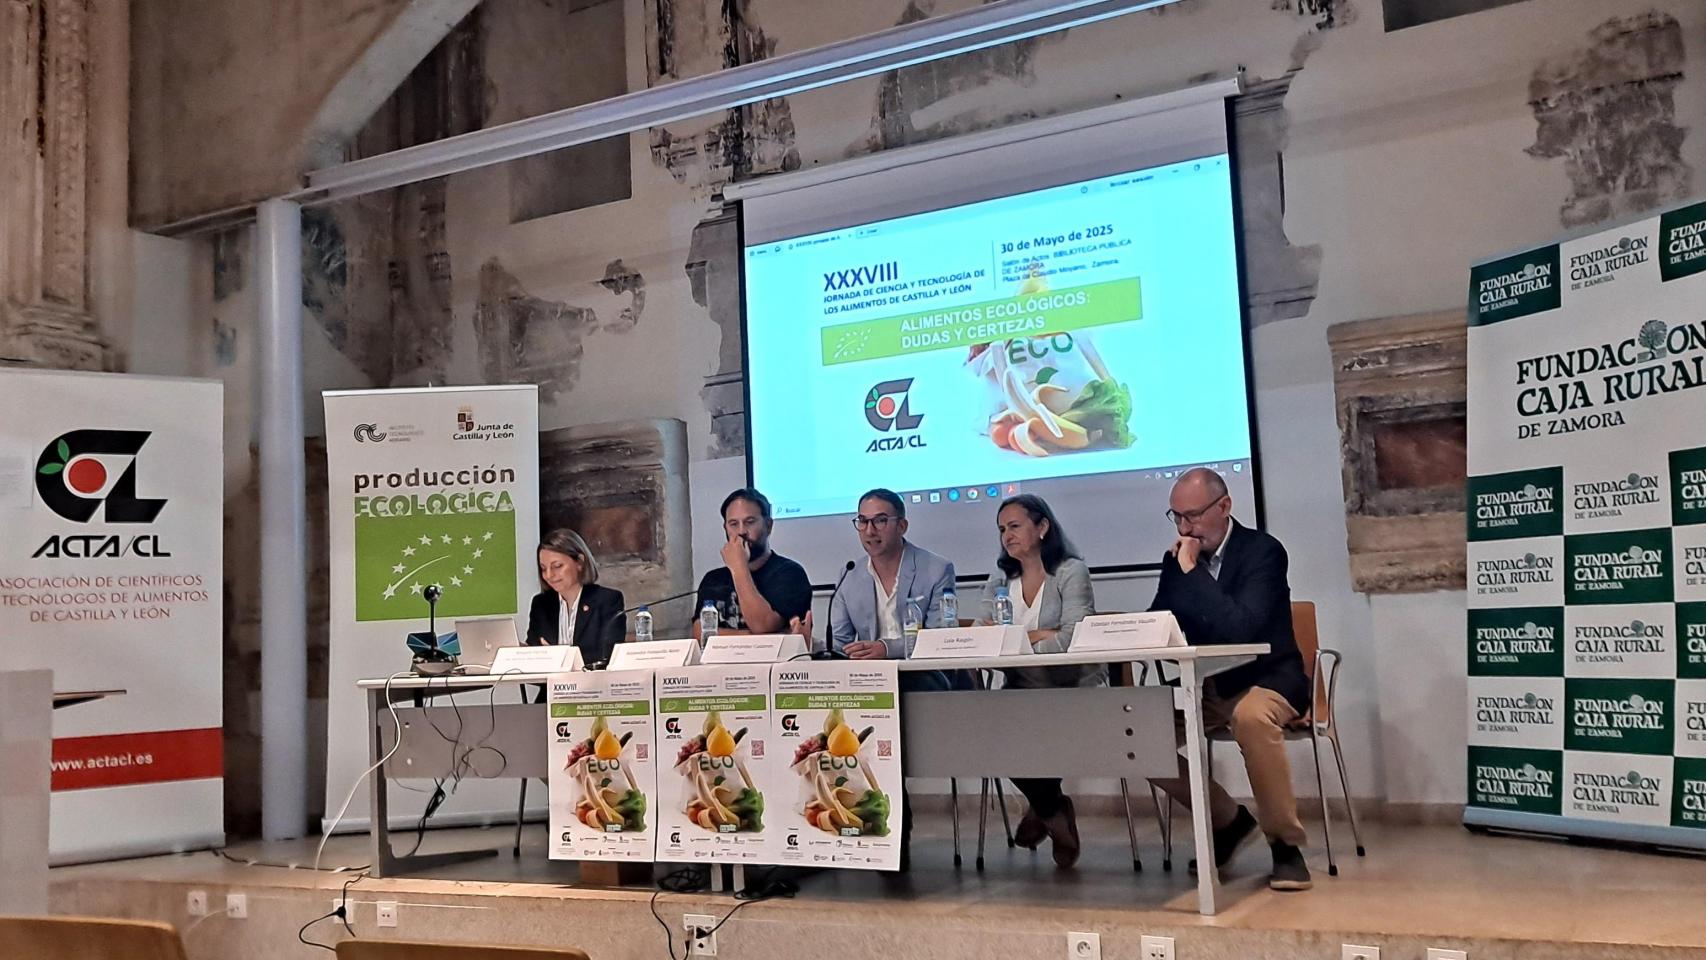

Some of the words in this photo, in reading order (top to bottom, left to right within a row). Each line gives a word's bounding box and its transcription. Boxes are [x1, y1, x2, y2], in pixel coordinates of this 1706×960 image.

[1001, 243, 1014, 254] 30
[1017, 240, 1030, 250] de
[1034, 235, 1064, 248] Mayo
[1068, 231, 1082, 241] de
[1086, 224, 1113, 238] 2025
[1669, 234, 1704, 254] CAJA
[1054, 246, 1097, 258] BIBLIOTECA
[1670, 256, 1682, 264] DE
[1014, 262, 1044, 272] ZAMORA
[1570, 266, 1601, 281] CAJA
[1605, 250, 1648, 272] RURAL
[824, 261, 898, 292] XXXVIII
[824, 291, 861, 303] JORNADA
[864, 288, 874, 297] DE
[876, 284, 908, 294] CIENCIA
[918, 271, 972, 288] TECNOLOGÍA
[974, 270, 986, 278] DE
[1480, 289, 1508, 304] CAJA
[1510, 278, 1552, 297] RURAL
[824, 306, 838, 314] LOS
[840, 298, 887, 312] ALIMENTOS
[889, 296, 900, 304] DE
[902, 290, 939, 302] CASTILLA
[950, 284, 972, 294] LEÓN
[901, 308, 982, 331] ALIMENTOS
[986, 291, 1090, 318] ECOLÓGICOS:
[902, 330, 950, 349] DUDAS
[954, 329, 963, 341] Y
[967, 316, 1045, 339] CERTEZAS
[1008, 331, 1074, 365] ECO
[1517, 380, 1593, 416] CAJA
[1603, 356, 1706, 404] RURAL
[453, 432, 483, 440] Castilla
[1518, 423, 1541, 439] DE
[866, 434, 927, 453] ACTA/CL
[354, 464, 514, 493] producción
[1574, 496, 1609, 510] CAJA
[1612, 490, 1660, 508] RURAL
[1477, 505, 1507, 520] CAJA
[1510, 500, 1554, 516] RURAL
[1574, 512, 1585, 520] DE
[31, 535, 171, 558] ACTA/CL
[96, 576, 113, 588] DE
[118, 572, 202, 587] CIENTÍFICOS
[1477, 572, 1506, 586] CAJA
[1510, 570, 1554, 584] RURAL
[1574, 567, 1609, 582] CAJA
[1613, 563, 1663, 580] RURAL
[1574, 583, 1586, 591] DE
[2, 592, 106, 606] TECNÓLOGOS
[112, 592, 128, 604] DE
[134, 590, 208, 602] ALIMENTOS
[30, 610, 48, 622] DE
[54, 609, 116, 622] CASTILLA
[122, 608, 128, 618] Y
[134, 606, 170, 619] LEÓN
[1477, 640, 1507, 654] CAJA
[1512, 640, 1554, 653] RURAL
[1575, 640, 1609, 652] CAJA
[1614, 640, 1664, 652] RURAL
[779, 672, 808, 680] XXXVIII
[1477, 710, 1506, 723] CAJA
[1510, 711, 1554, 724] RURAL
[1574, 714, 1609, 728] CAJA
[1613, 714, 1664, 730] RURAL
[1574, 728, 1585, 736] DE
[588, 758, 620, 774] ECO
[700, 756, 734, 771] ECO
[818, 755, 858, 771] ECO
[1476, 780, 1506, 794] CAJA
[1509, 782, 1553, 798] RURAL
[1573, 788, 1606, 802] CAJA
[1612, 790, 1660, 806] RURAL
